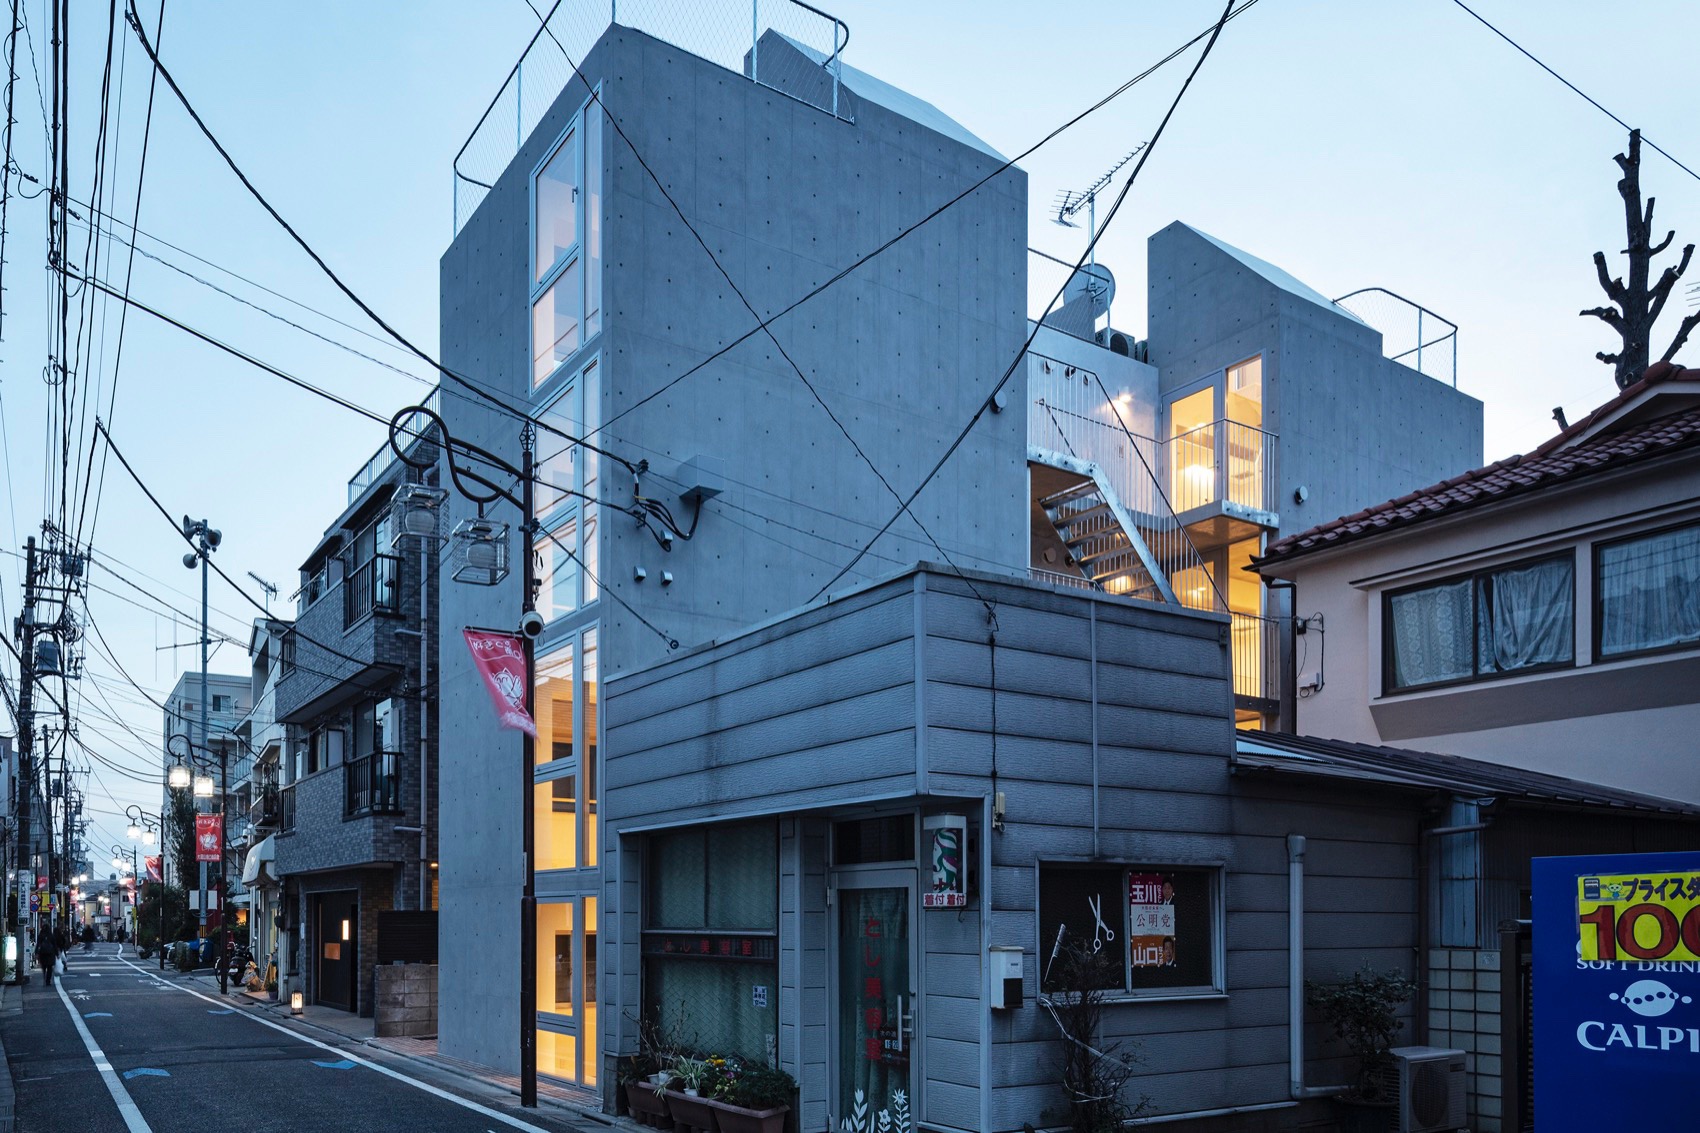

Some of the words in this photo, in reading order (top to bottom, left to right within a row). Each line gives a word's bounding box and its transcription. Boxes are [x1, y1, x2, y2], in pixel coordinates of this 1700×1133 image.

[1132, 885, 1157, 904] 玉川
[1136, 913, 1171, 928] 公明党
[1134, 946, 1158, 965] 山口
